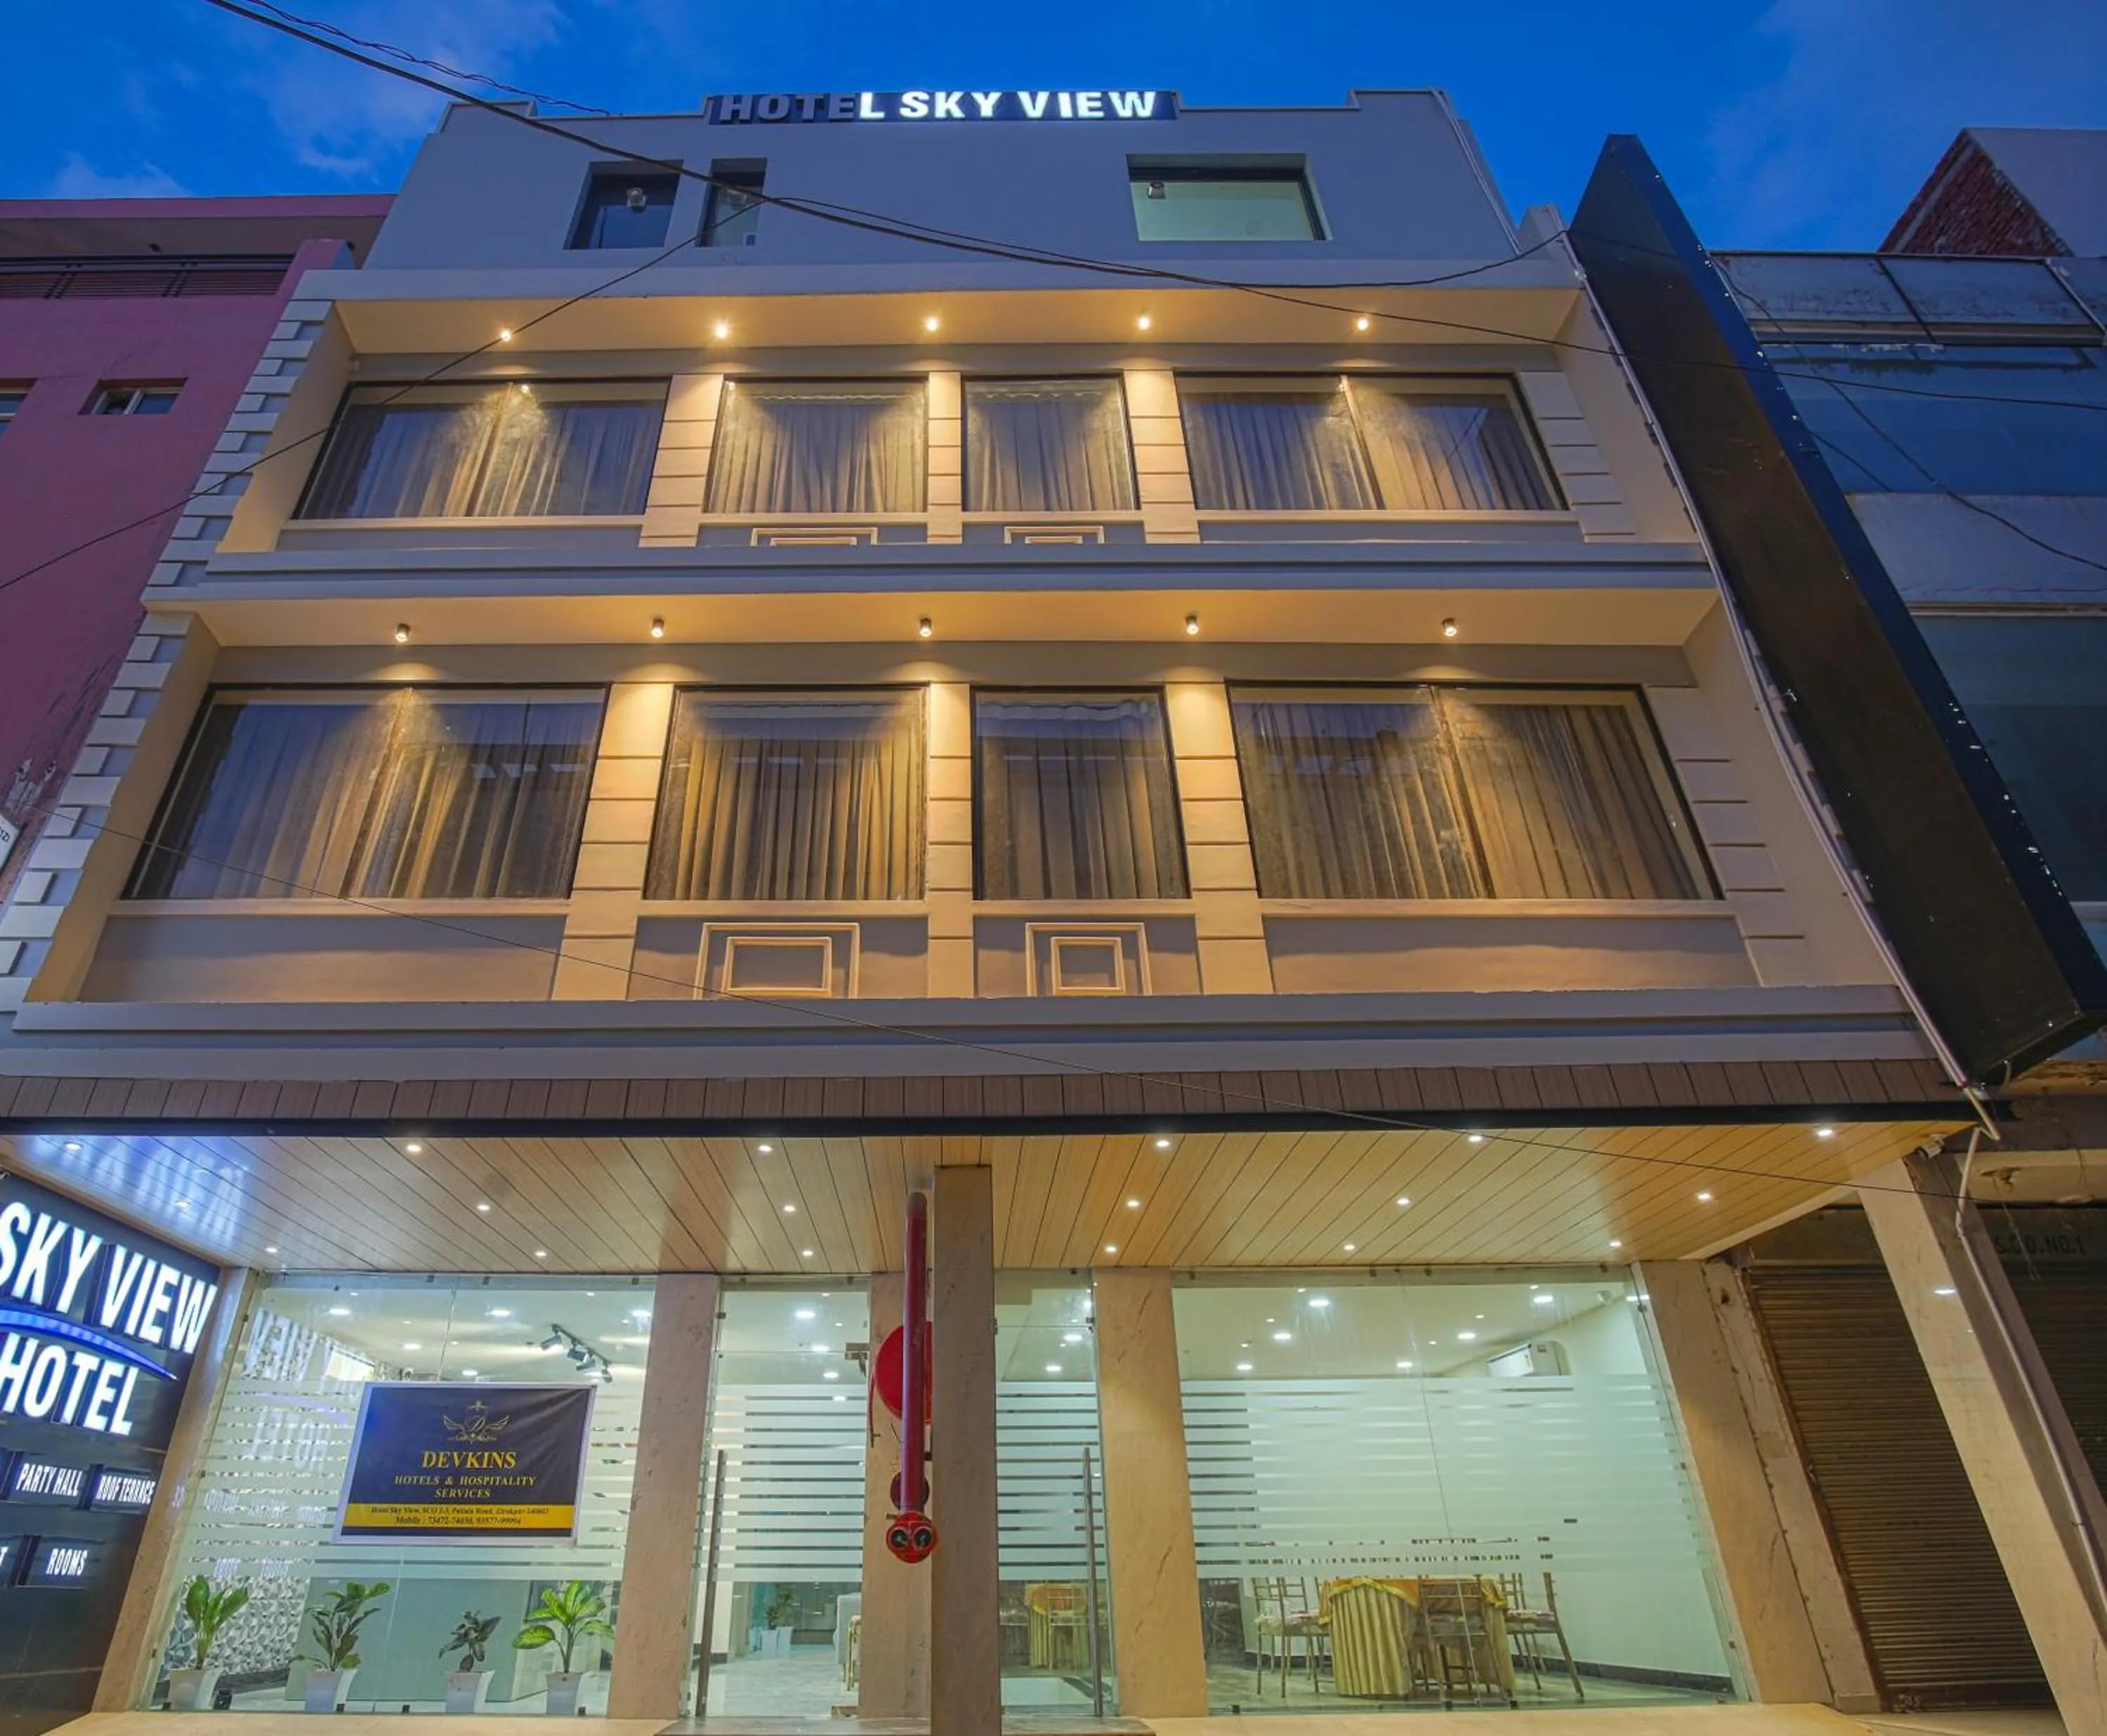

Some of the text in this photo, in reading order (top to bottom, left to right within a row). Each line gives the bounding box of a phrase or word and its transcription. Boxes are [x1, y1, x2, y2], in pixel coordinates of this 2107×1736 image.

[719, 91, 1155, 122] HOTEL SKY VIEW
[0, 1202, 218, 1354] SKY VIEW
[0, 1331, 139, 1435] HOTEL
[422, 1451, 516, 1468] DEVKINS
[15, 1463, 84, 1497] PARTY HALL
[95, 1475, 156, 1505] ROOF TERRACE
[395, 1475, 537, 1485] HOTELS & HOSPITALITY
[434, 1488, 491, 1498] SERVICES
[46, 1548, 88, 1576] ROOMS
